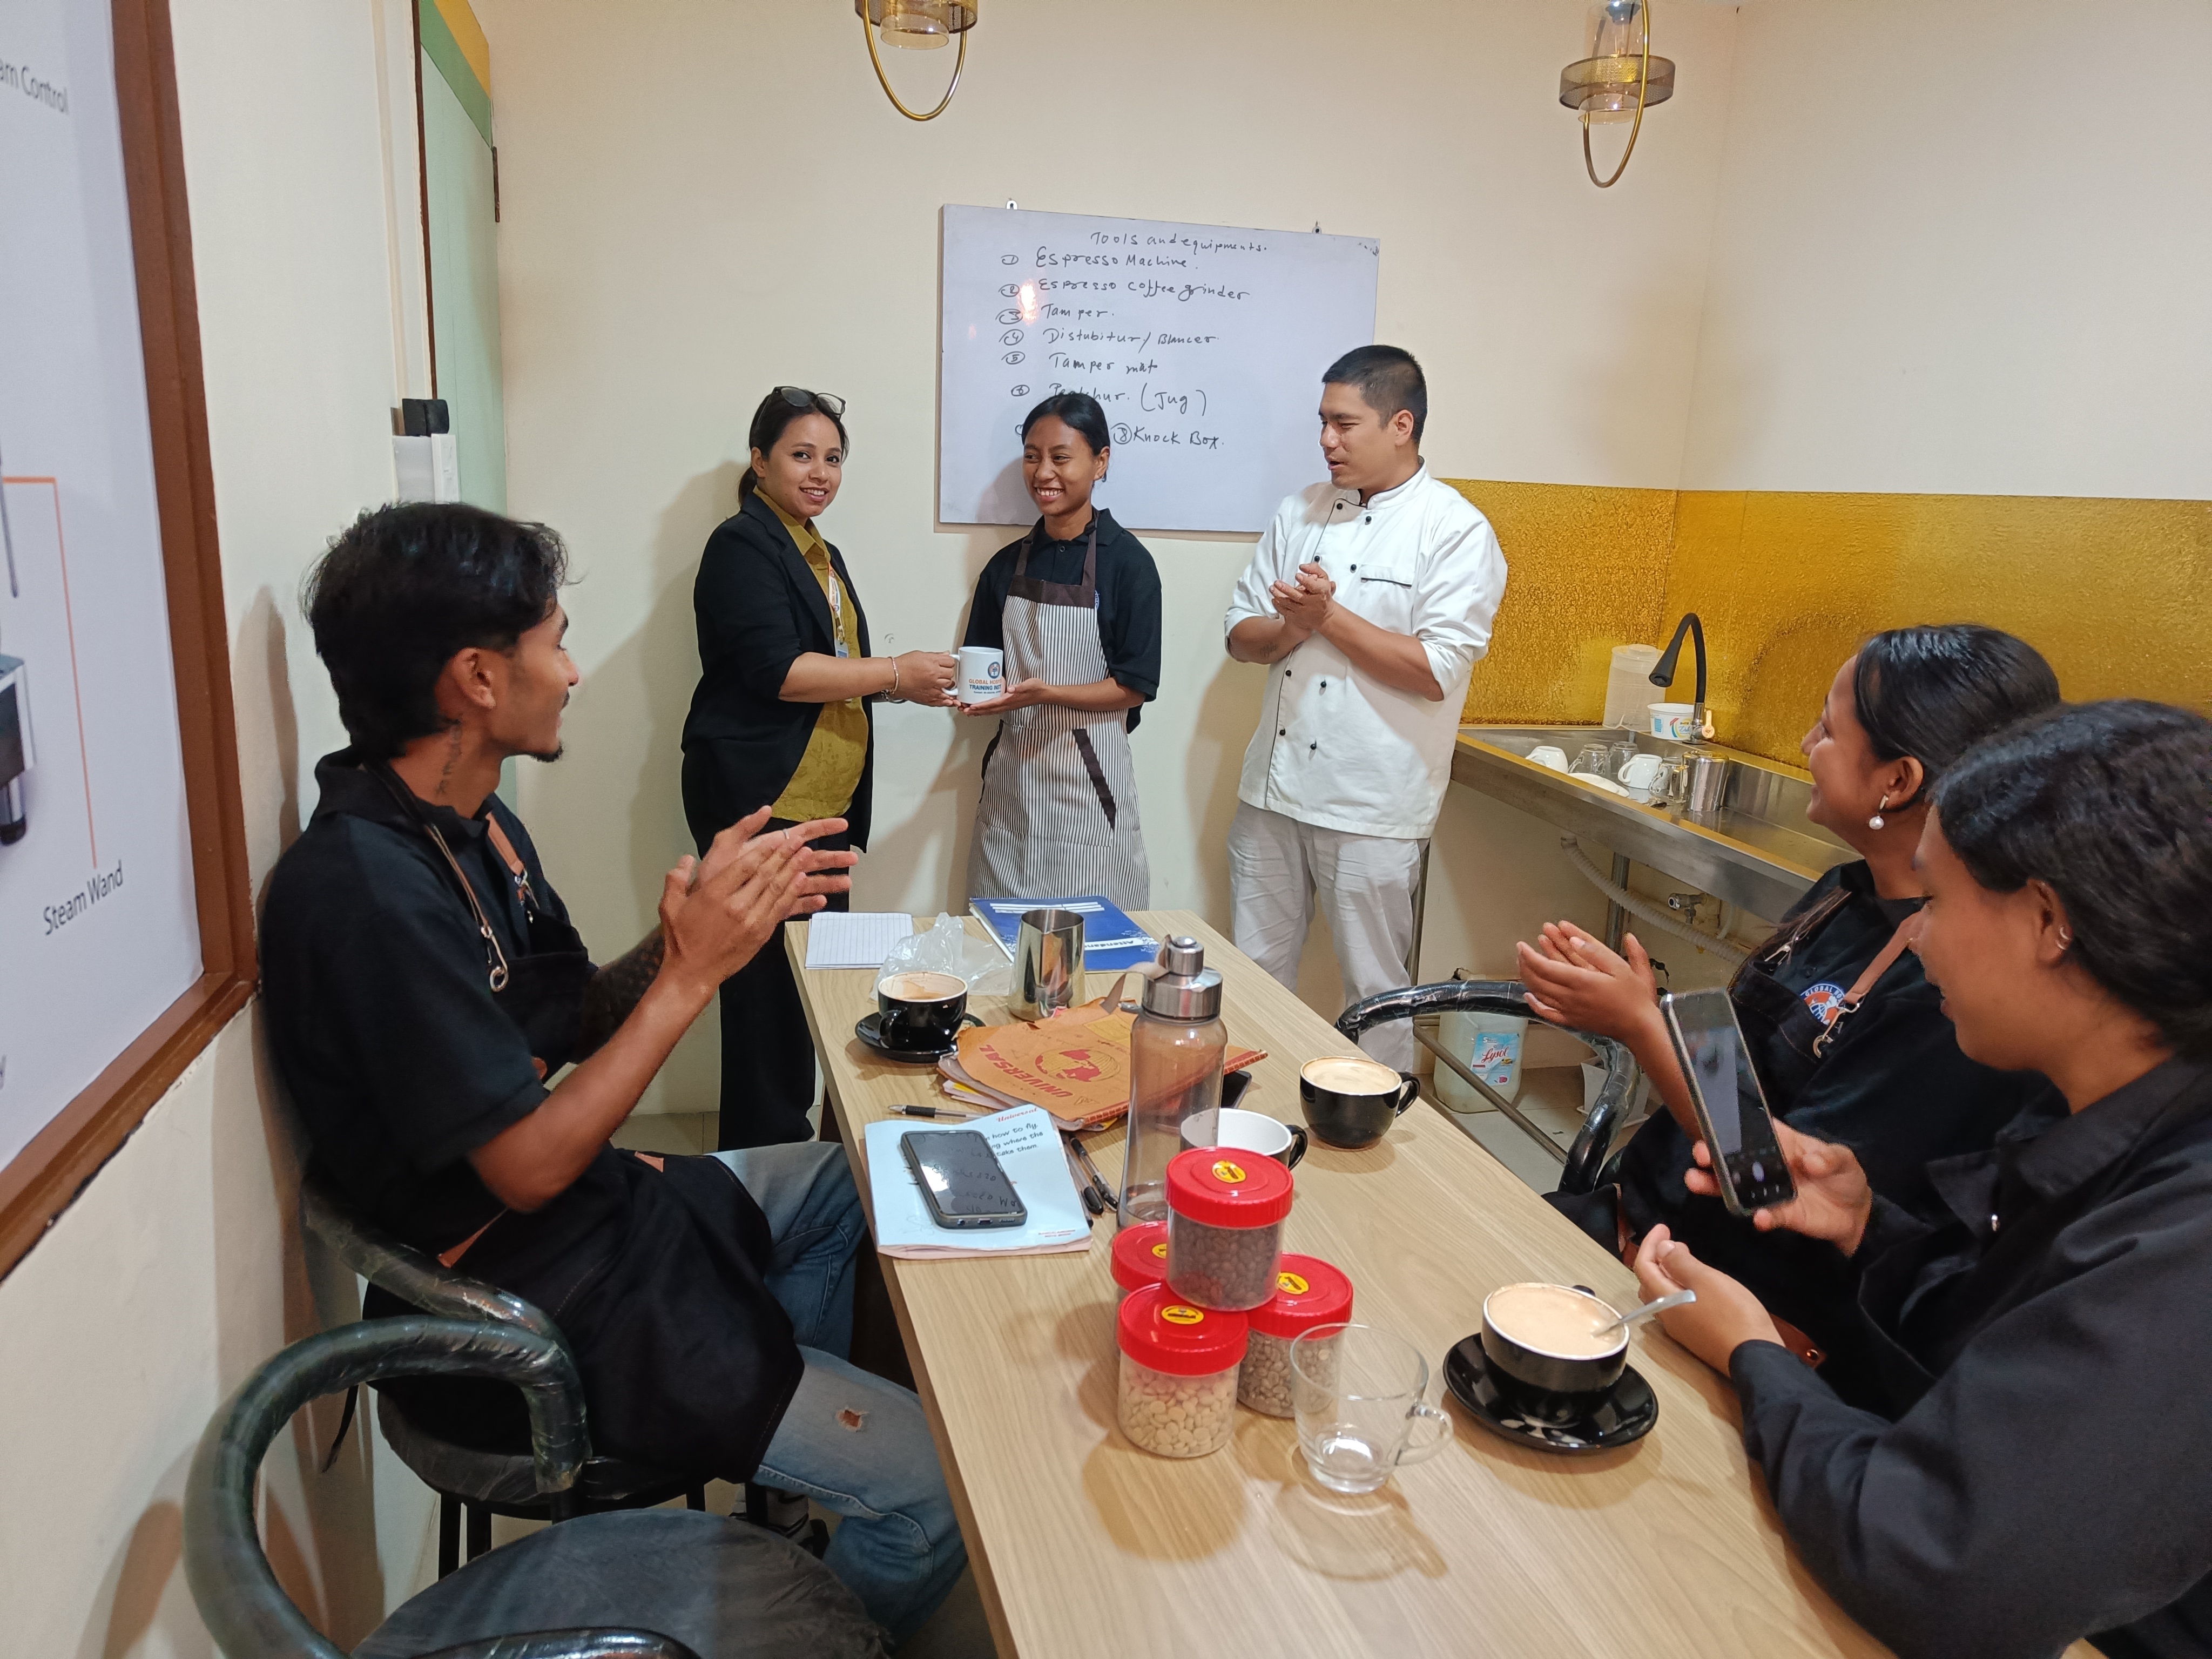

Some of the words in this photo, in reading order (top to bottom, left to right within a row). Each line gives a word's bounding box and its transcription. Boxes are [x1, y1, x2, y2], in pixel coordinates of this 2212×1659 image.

[21, 65, 69, 115] Control
[1091, 232, 1138, 245] Tools
[1147, 233, 1176, 245] and
[1036, 246, 1118, 267] Espresso
[1038, 278, 1116, 290] Espresso
[1049, 352, 1115, 373] Tamper
[1134, 426, 1181, 444] Knock
[43, 892, 87, 936] Steam
[86, 859, 124, 905] Wand
[1805, 986, 1833, 997] GLOBAL
[1481, 1045, 1510, 1063] Lysol
[979, 1044, 1074, 1097] UNIVERSAL
[992, 1130, 1010, 1139] how
[1003, 1136, 1027, 1146] where
[1029, 1131, 1043, 1139] the
